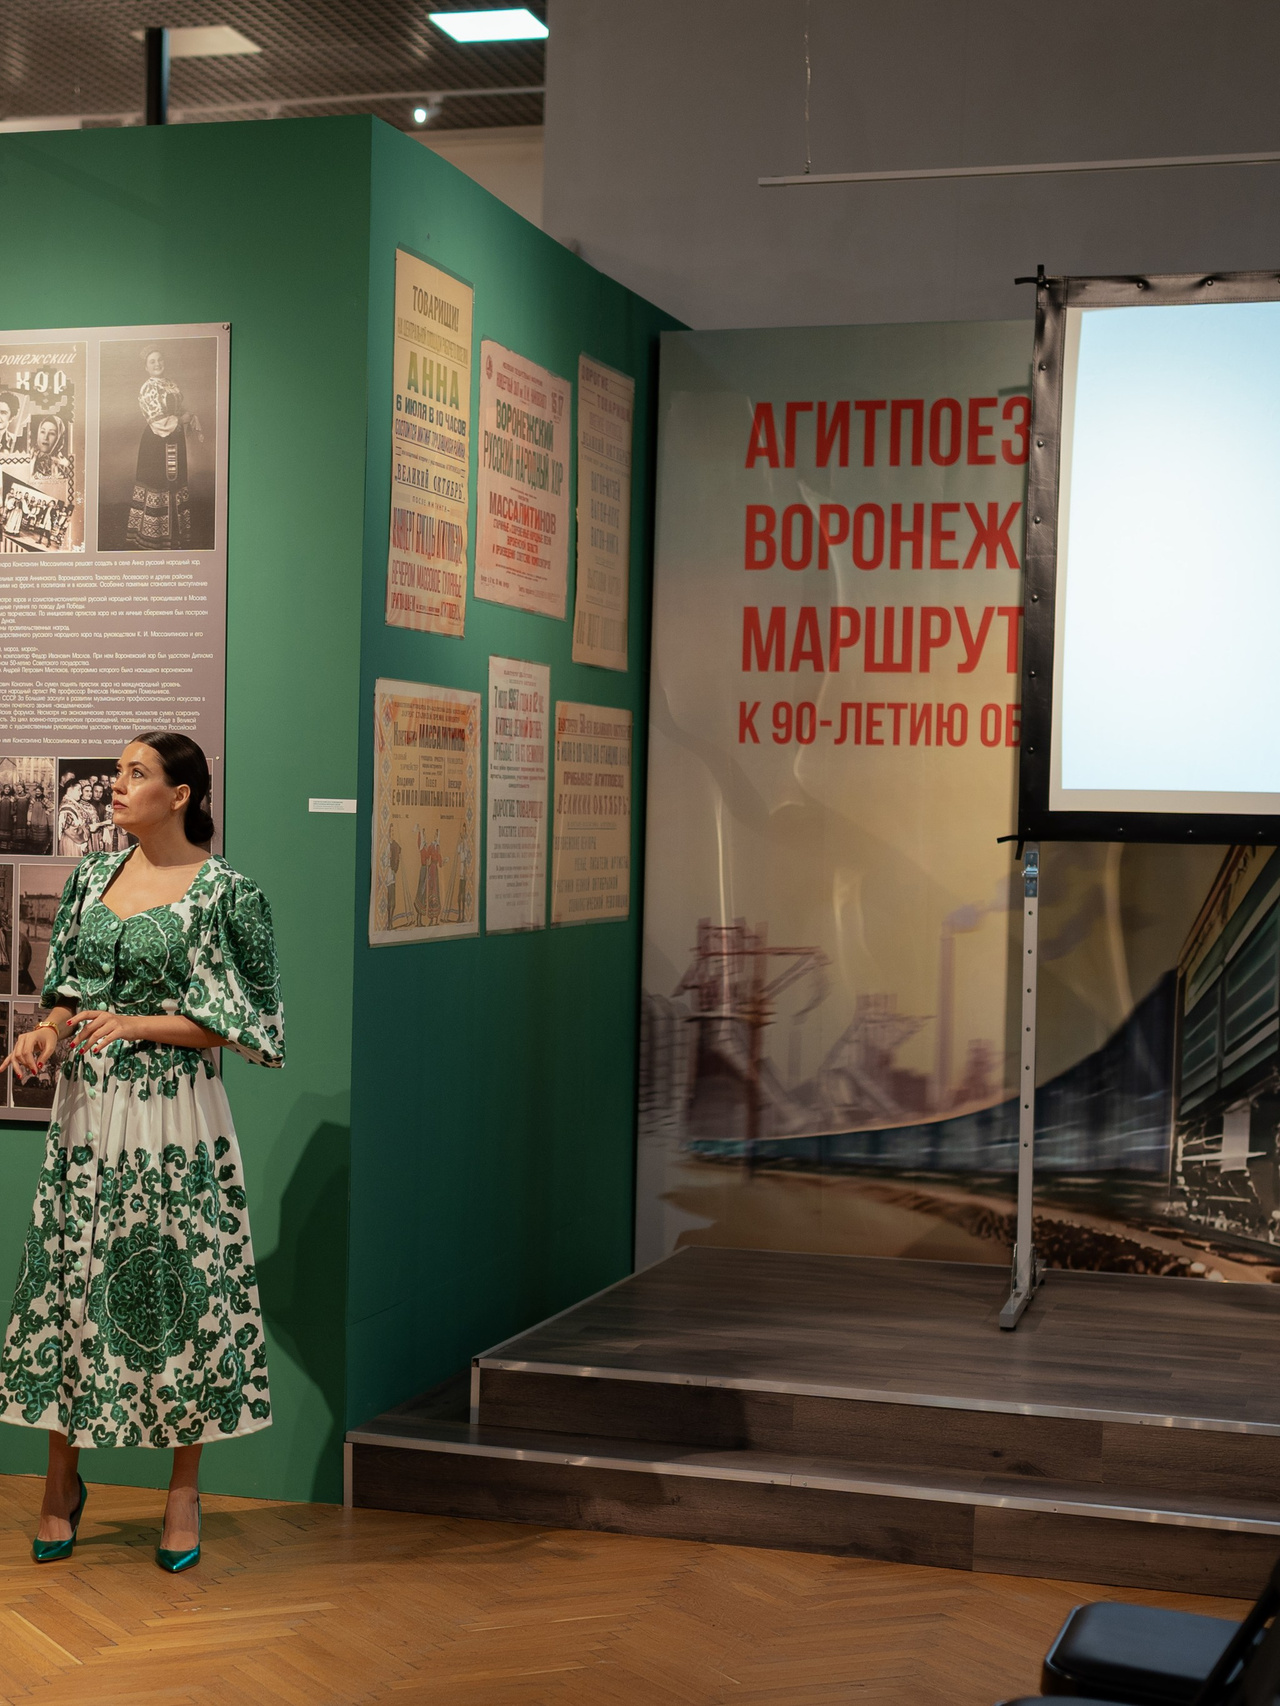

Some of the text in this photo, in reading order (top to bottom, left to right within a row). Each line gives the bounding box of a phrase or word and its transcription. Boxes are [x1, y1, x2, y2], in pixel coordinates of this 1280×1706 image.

[412, 285, 460, 333] ТОВАРИЩИ!
[16, 370, 67, 395] ХОР
[407, 350, 460, 411] АННА
[581, 364, 609, 392] ДОРОГИЕ
[396, 394, 467, 437] 6 ИЮЛЯ В 10 ЧАСОВ
[496, 398, 554, 452] ВОРОНЕЖСКИЙ
[744, 395, 1032, 469] АГИТПОЕЗ
[483, 430, 514, 478] РУССКИЙ
[515, 444, 550, 492] НАРОДНЫЙ
[551, 459, 564, 496] ХОР
[489, 491, 557, 535] МАССАЛИТИНОВ
[744, 501, 1023, 572] ВОРОНЕЖ
[392, 559, 416, 588] ВЕЧЕРОМ
[741, 606, 1024, 674] МАРШРУТ
[418, 723, 466, 752] МАССАЛИТИНОВ
[738, 701, 761, 744] К
[771, 701, 969, 748] 90-ЛЕТИЮ
[392, 789, 418, 806] ЕФИМОВ
